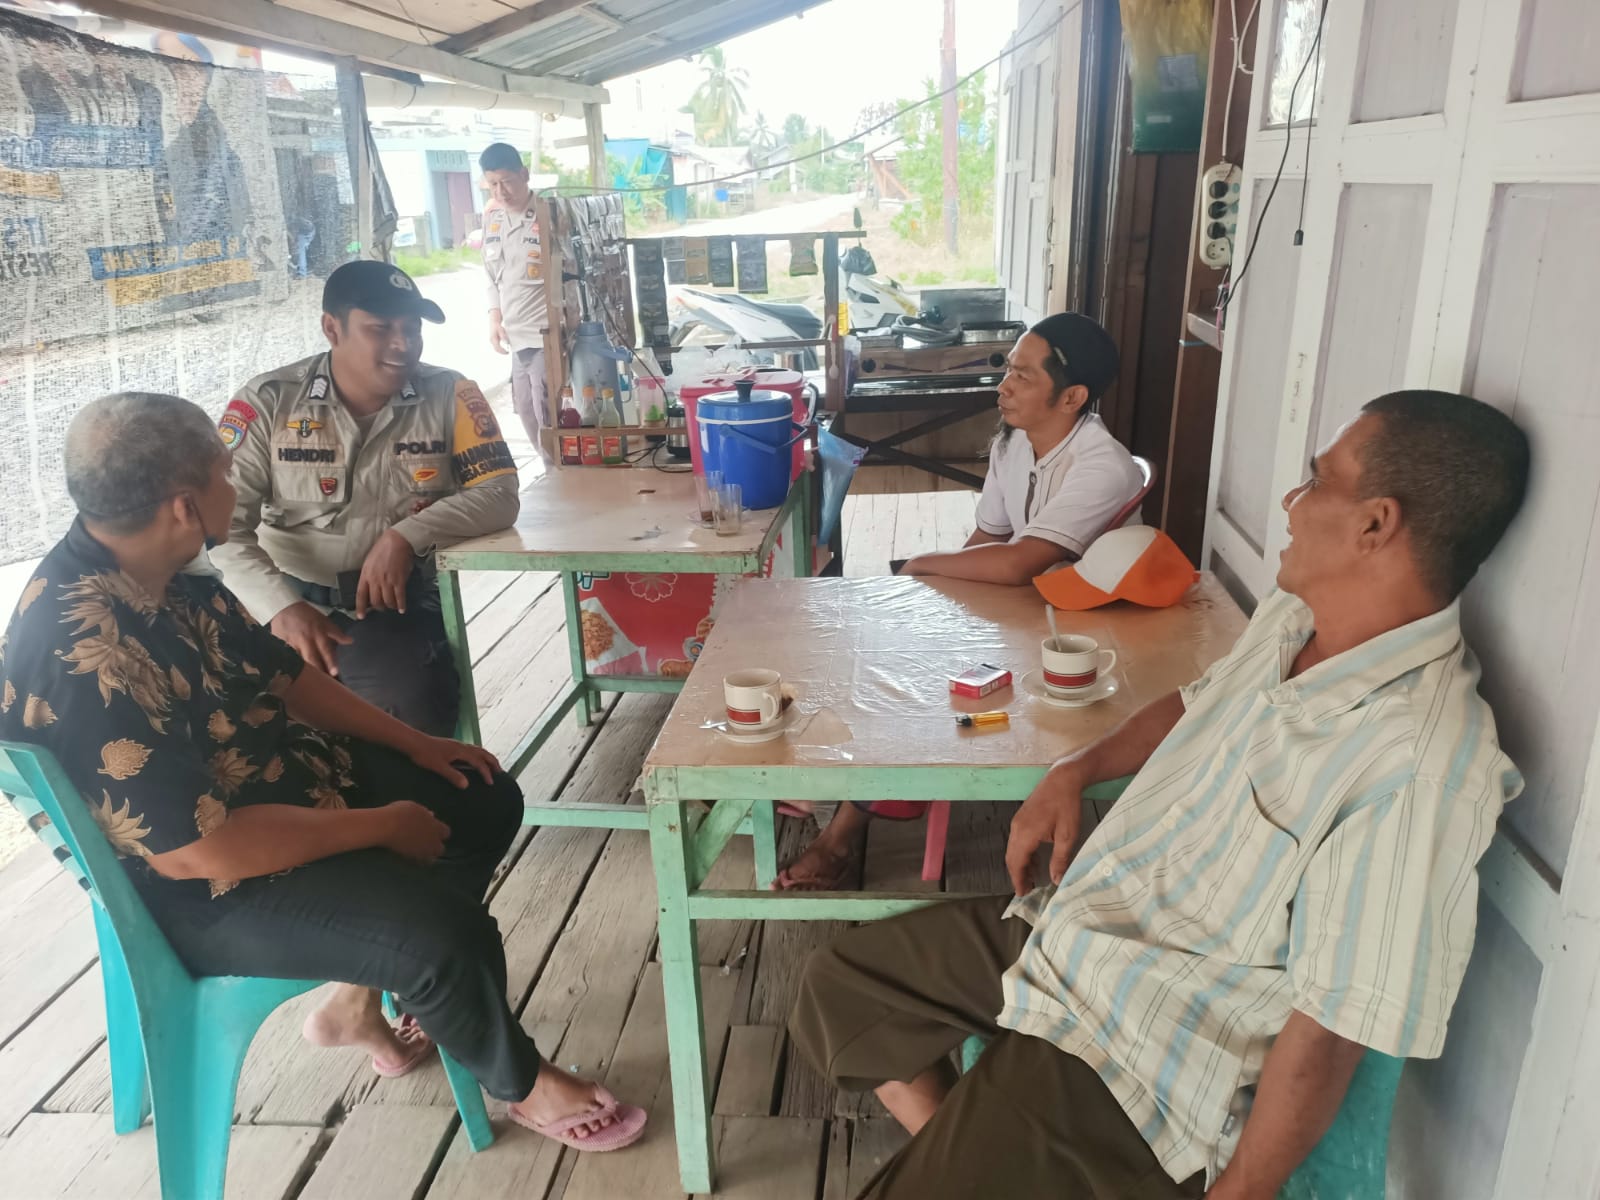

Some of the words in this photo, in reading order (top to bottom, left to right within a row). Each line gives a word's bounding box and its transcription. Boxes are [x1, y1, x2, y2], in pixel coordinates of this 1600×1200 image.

[522, 236, 541, 245] POL
[278, 447, 336, 463] HENDRI
[392, 440, 447, 455] POLRI
